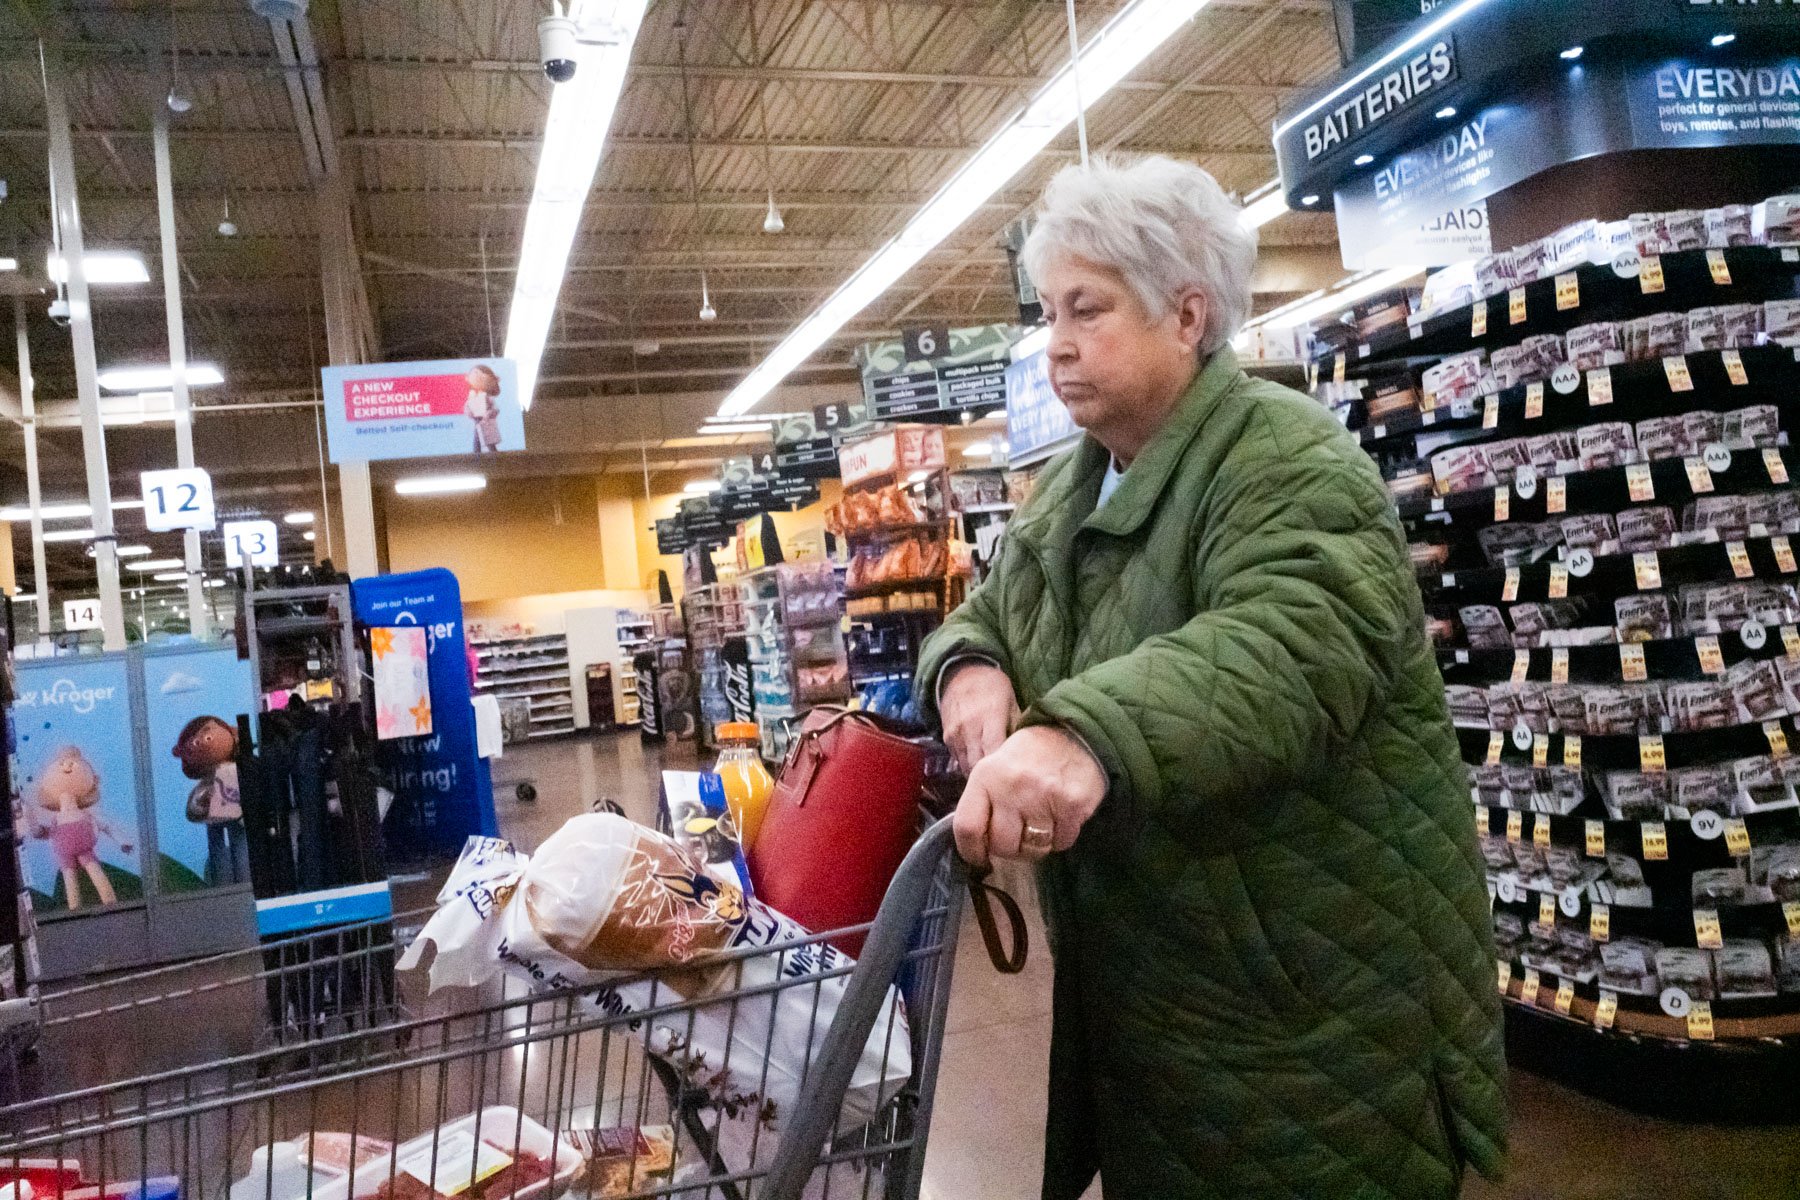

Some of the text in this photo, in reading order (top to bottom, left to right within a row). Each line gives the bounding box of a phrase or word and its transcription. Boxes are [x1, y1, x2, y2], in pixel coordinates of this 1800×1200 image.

[1304, 41, 1451, 161] BATTERIES
[1659, 101, 1800, 117] perfect for general devices
[1660, 120, 1688, 134] toys,
[1690, 119, 1738, 131] remotes,
[1740, 117, 1760, 129] and
[1374, 115, 1488, 199] EVERYDAY
[1478, 148, 1494, 164] like
[1559, 227, 1596, 252] Energizer
[1615, 257, 1640, 268] AAA
[1557, 286, 1578, 297] 4.99
[918, 330, 936, 355] 6
[1570, 326, 1611, 349] Energizer
[981, 362, 1004, 371] snacks
[351, 381, 394, 393] A NEW
[891, 376, 910, 386] chips
[1554, 373, 1577, 385] AAA
[353, 391, 420, 406] CHECKOUT
[889, 389, 915, 399] cookies
[981, 391, 999, 401] chips
[353, 403, 431, 419] EXPERIENCE
[825, 405, 838, 426] 5
[890, 403, 918, 413] crackers
[355, 421, 454, 435] Belted Self-checkout
[1639, 421, 1684, 442] Energizer
[1581, 426, 1624, 449] Energizer
[761, 454, 773, 471] 4
[1706, 452, 1729, 462] AAA
[1517, 479, 1535, 490] AAA
[150, 483, 200, 514] 12
[1566, 520, 1604, 538] Energizer
[231, 532, 267, 555] 13
[1571, 554, 1589, 570] AA
[372, 594, 435, 610] Join our Team at
[68, 606, 95, 623] 14
[1745, 629, 1762, 640] AA
[1622, 657, 1643, 666] 7.99
[43, 678, 115, 714] Kroger
[1690, 687, 1735, 707] Energizer
[1515, 731, 1529, 741] AA
[1642, 750, 1663, 760] 4.99
[1617, 777, 1664, 796] Energizer
[1683, 774, 1728, 795] Energizer
[1697, 818, 1716, 831] 9V
[1502, 884, 1510, 895] C
[1565, 897, 1573, 909] C
[1670, 996, 1682, 1009] D
